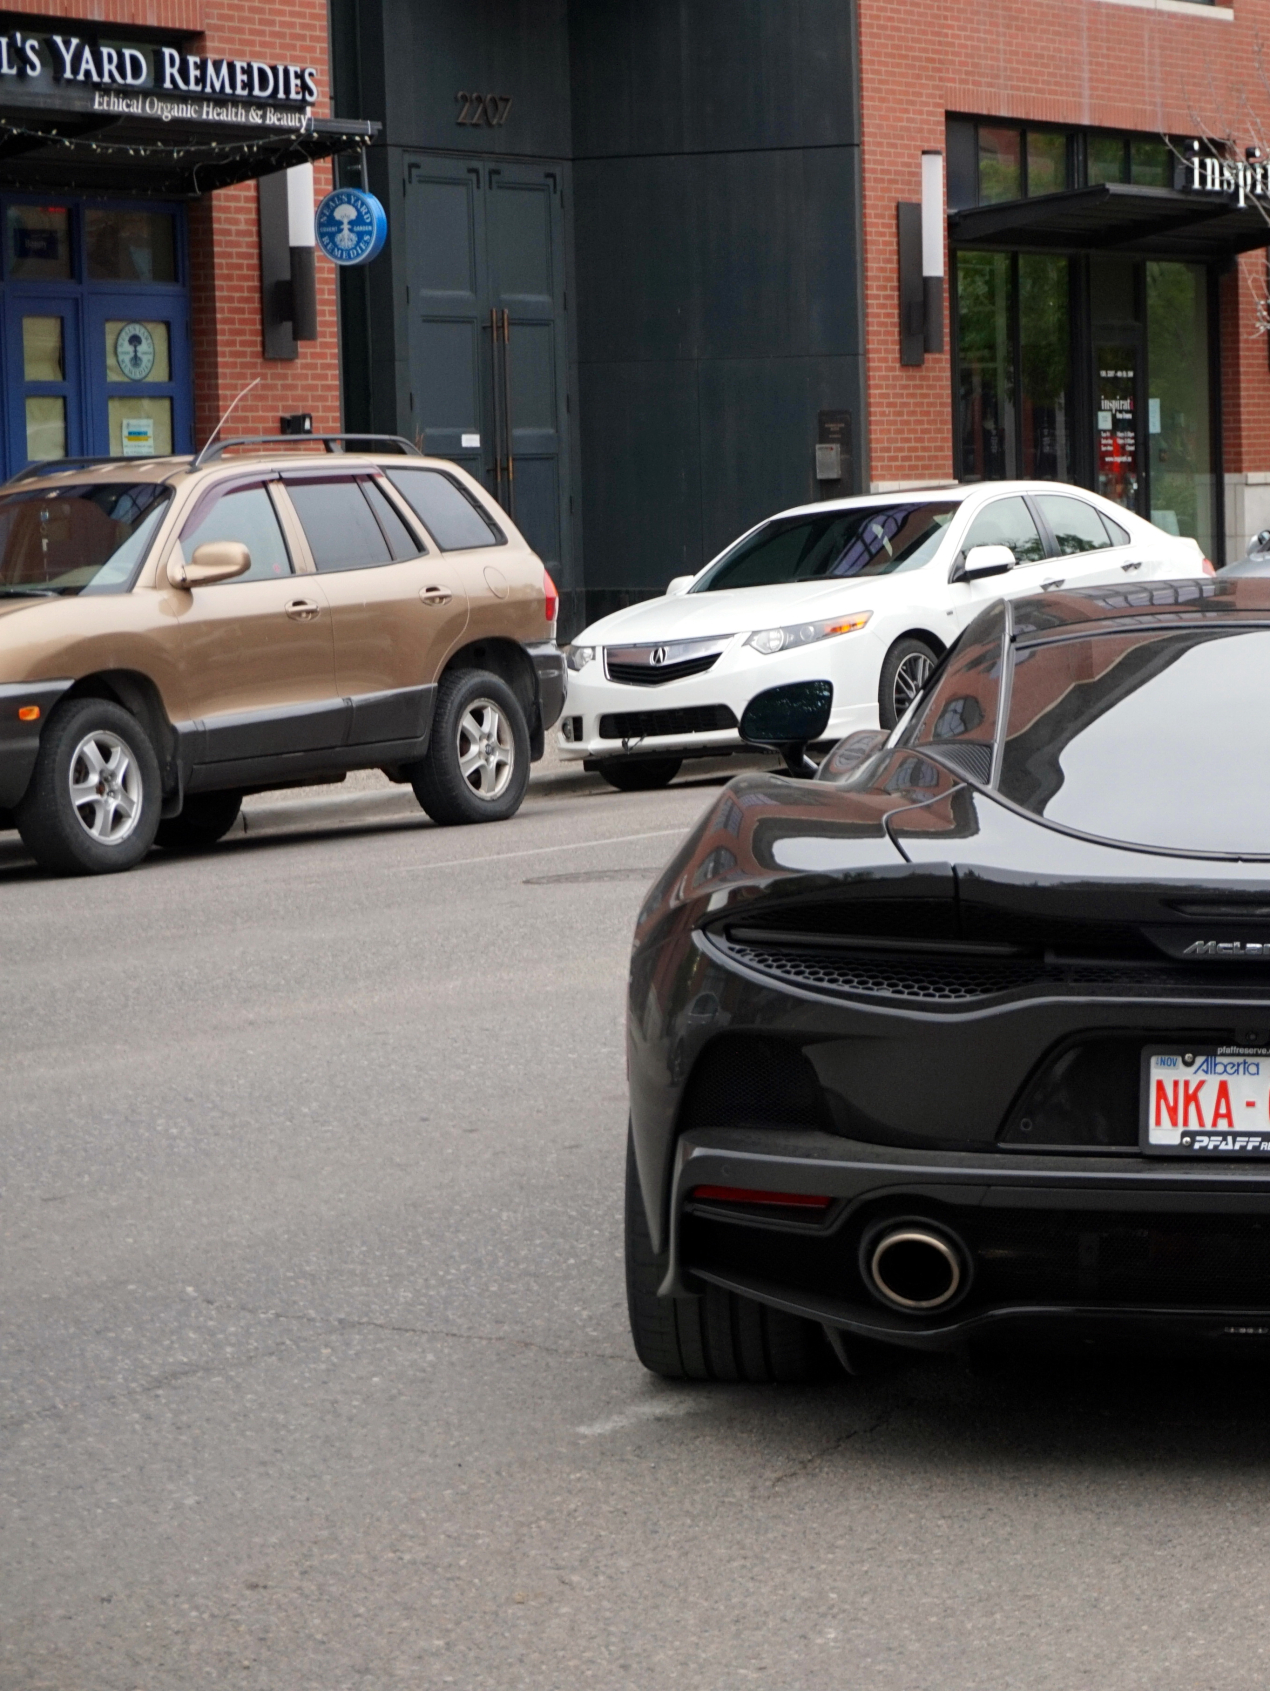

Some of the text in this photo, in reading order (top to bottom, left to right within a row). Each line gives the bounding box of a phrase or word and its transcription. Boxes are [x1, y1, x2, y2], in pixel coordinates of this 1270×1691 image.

[53, 35, 148, 86] YARD
[161, 47, 319, 102] REMEDIES
[93, 91, 309, 131] Ethical Organic Health & Beauty
[454, 91, 513, 128] 2207
[320, 194, 371, 223] NEAL'S YARD
[322, 234, 371, 259] REMEDIES
[1160, 1057, 1178, 1067] NOV
[1193, 1057, 1260, 1076] Alberta
[1193, 1135, 1262, 1150] PFAFF
